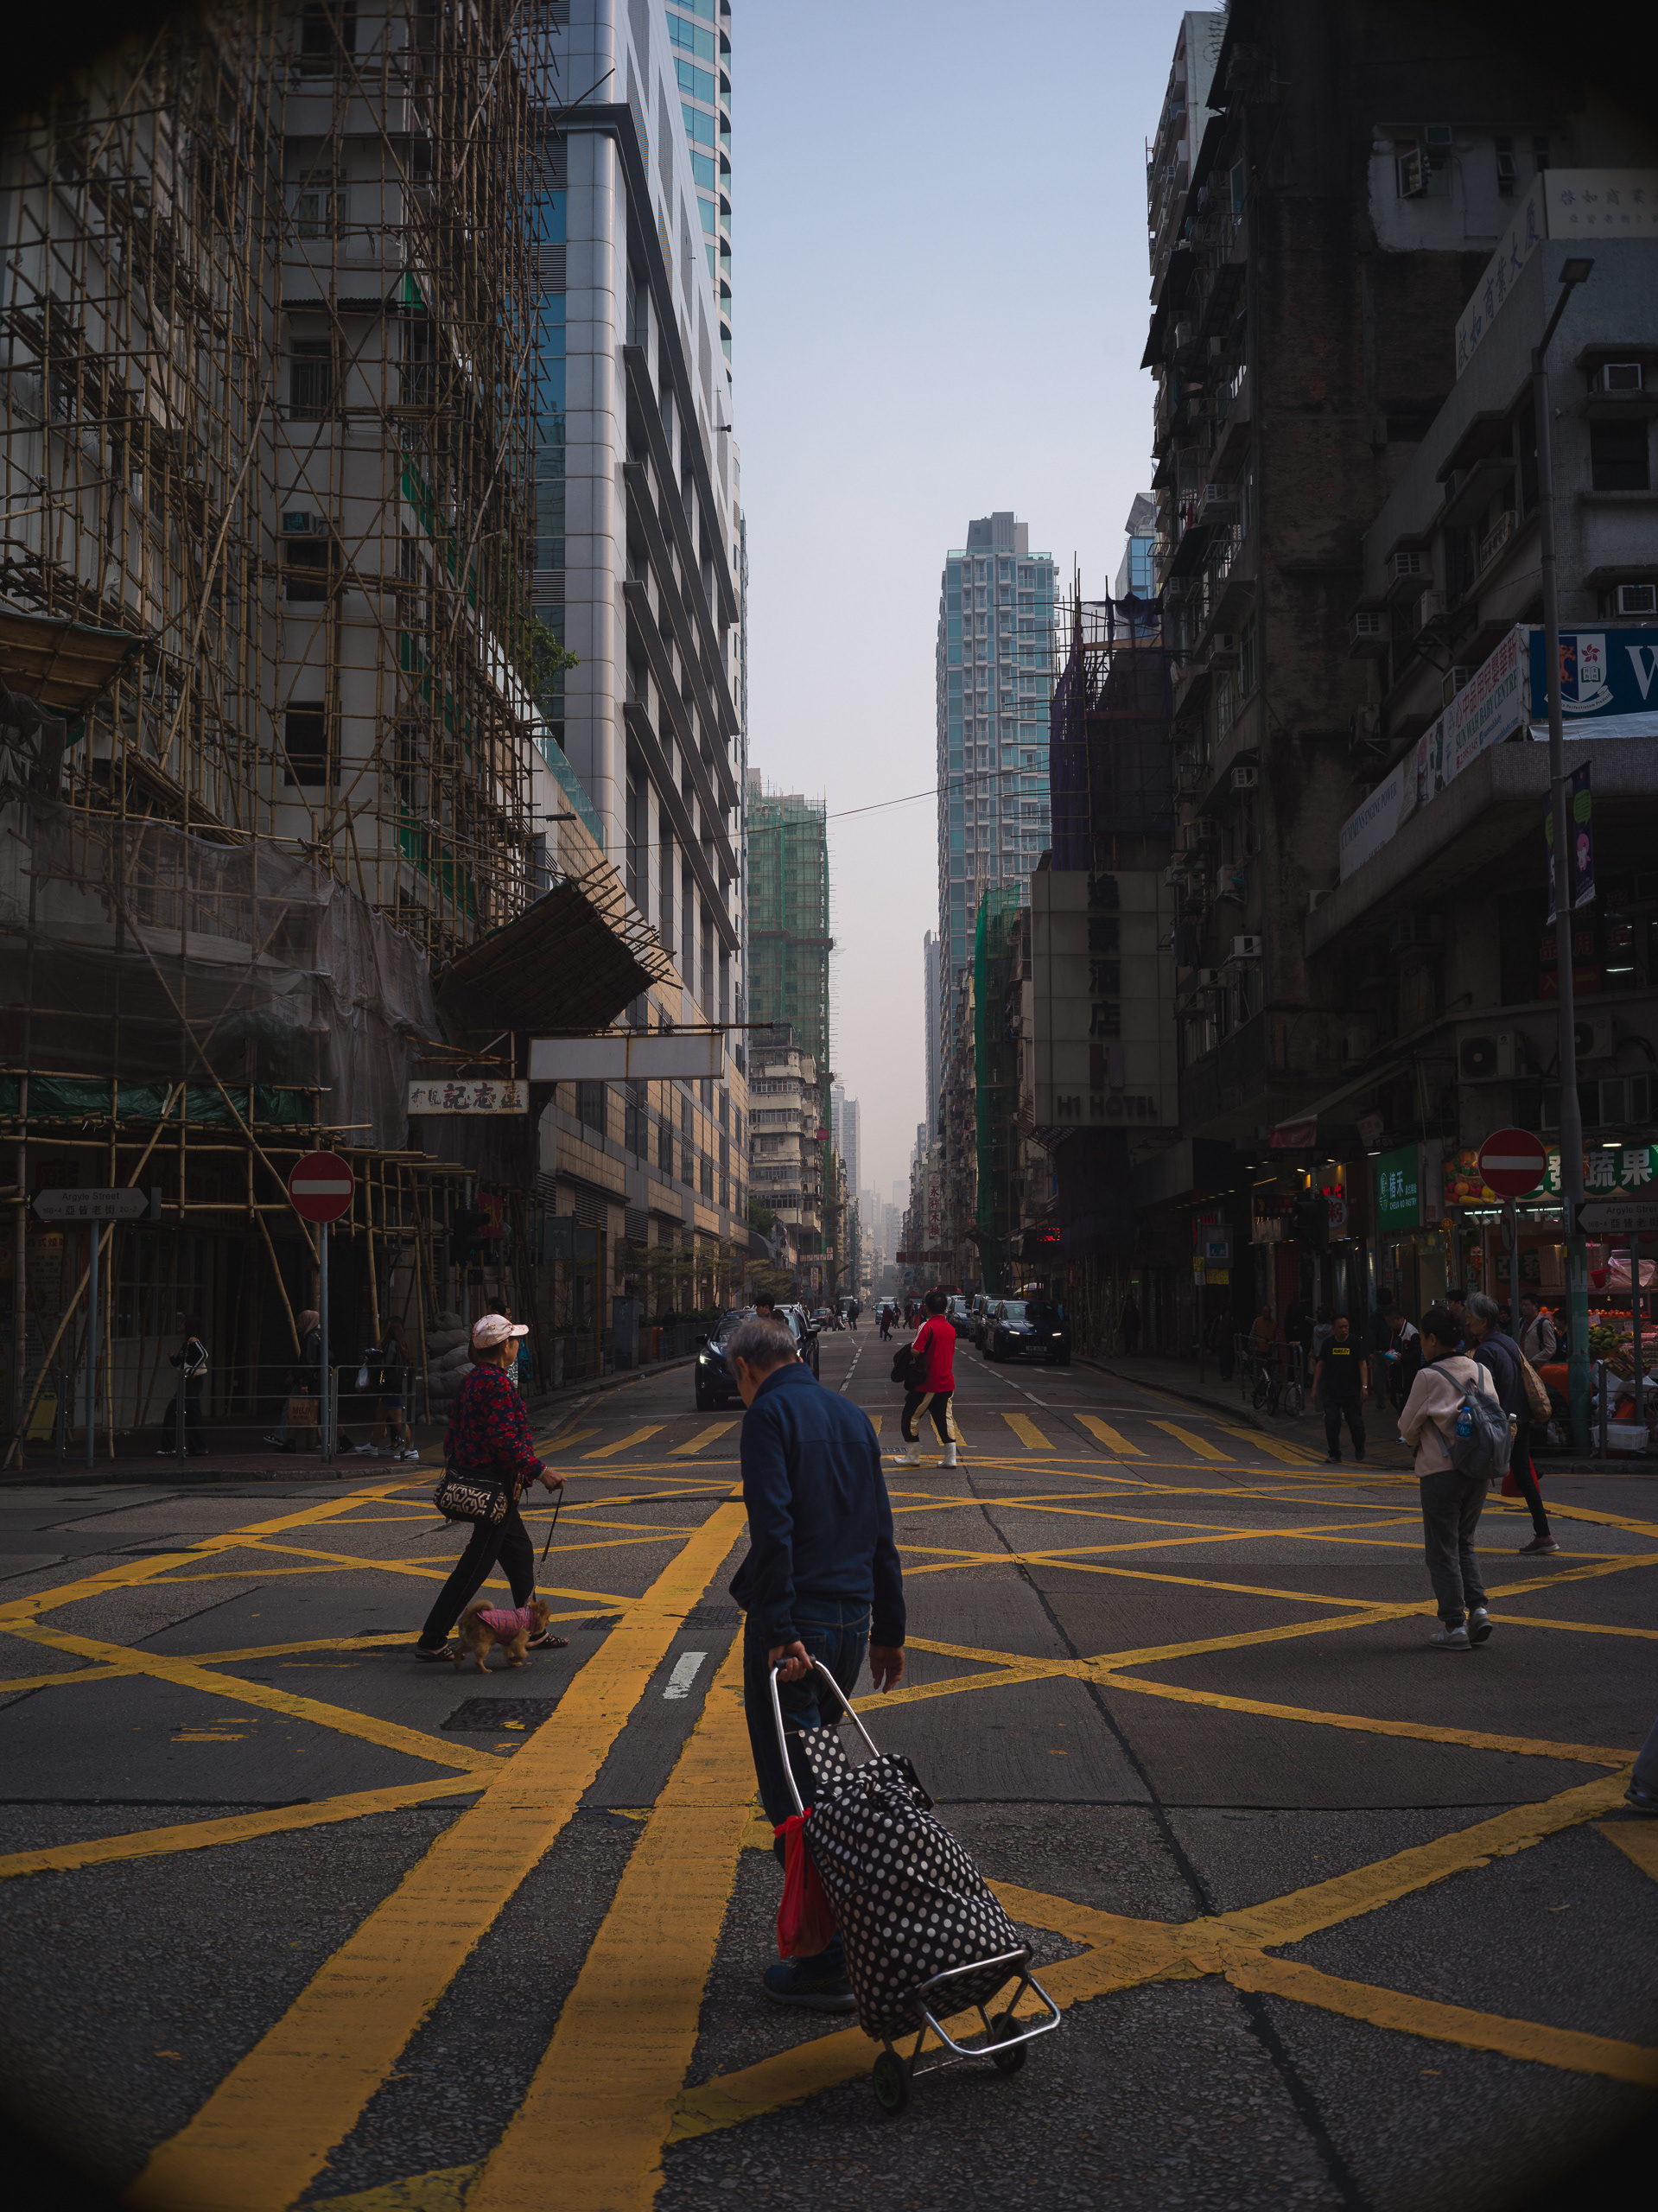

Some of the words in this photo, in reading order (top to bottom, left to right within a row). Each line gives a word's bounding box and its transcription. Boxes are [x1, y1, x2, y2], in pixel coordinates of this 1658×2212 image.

[1479, 695, 1494, 727] BABY
[1494, 668, 1518, 709] CENTRE
[1058, 1095, 1081, 1116] H1
[1090, 1095, 1158, 1116] HOTEL
[62, 1192, 89, 1203] Argyle
[92, 1192, 120, 1200] Street
[66, 1205, 116, 1216] 亞皆老街
[1606, 1206, 1633, 1216] Argyle
[1636, 1205, 1658, 1214] Stree
[292, 1407, 311, 1415] MUJI
